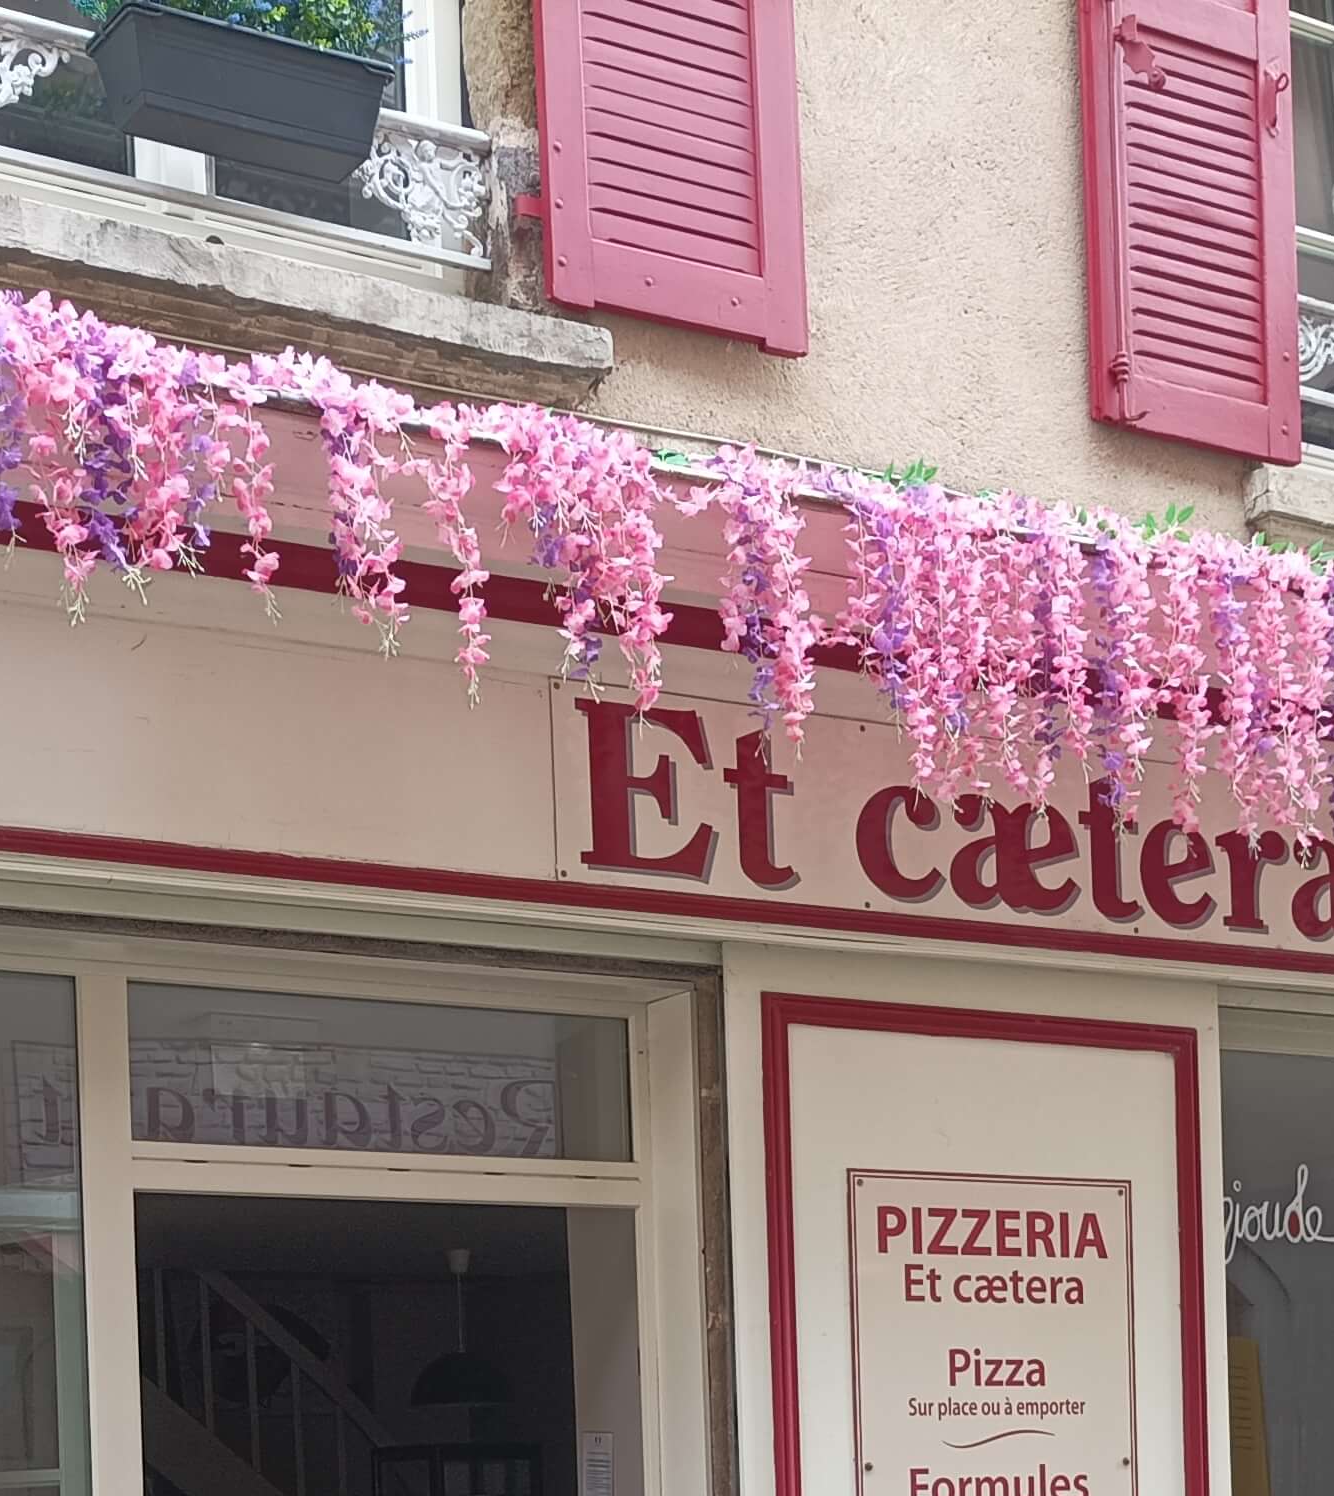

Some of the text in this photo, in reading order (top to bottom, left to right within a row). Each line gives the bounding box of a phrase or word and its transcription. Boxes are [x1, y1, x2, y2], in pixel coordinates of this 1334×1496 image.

[575, 697, 801, 889] Et
[876, 1205, 1108, 1259] PIZZERIA
[904, 1263, 1084, 1304] Et cætera
[948, 1347, 1046, 1387] Pizza
[908, 1397, 1086, 1420] Sur place ou à emporter
